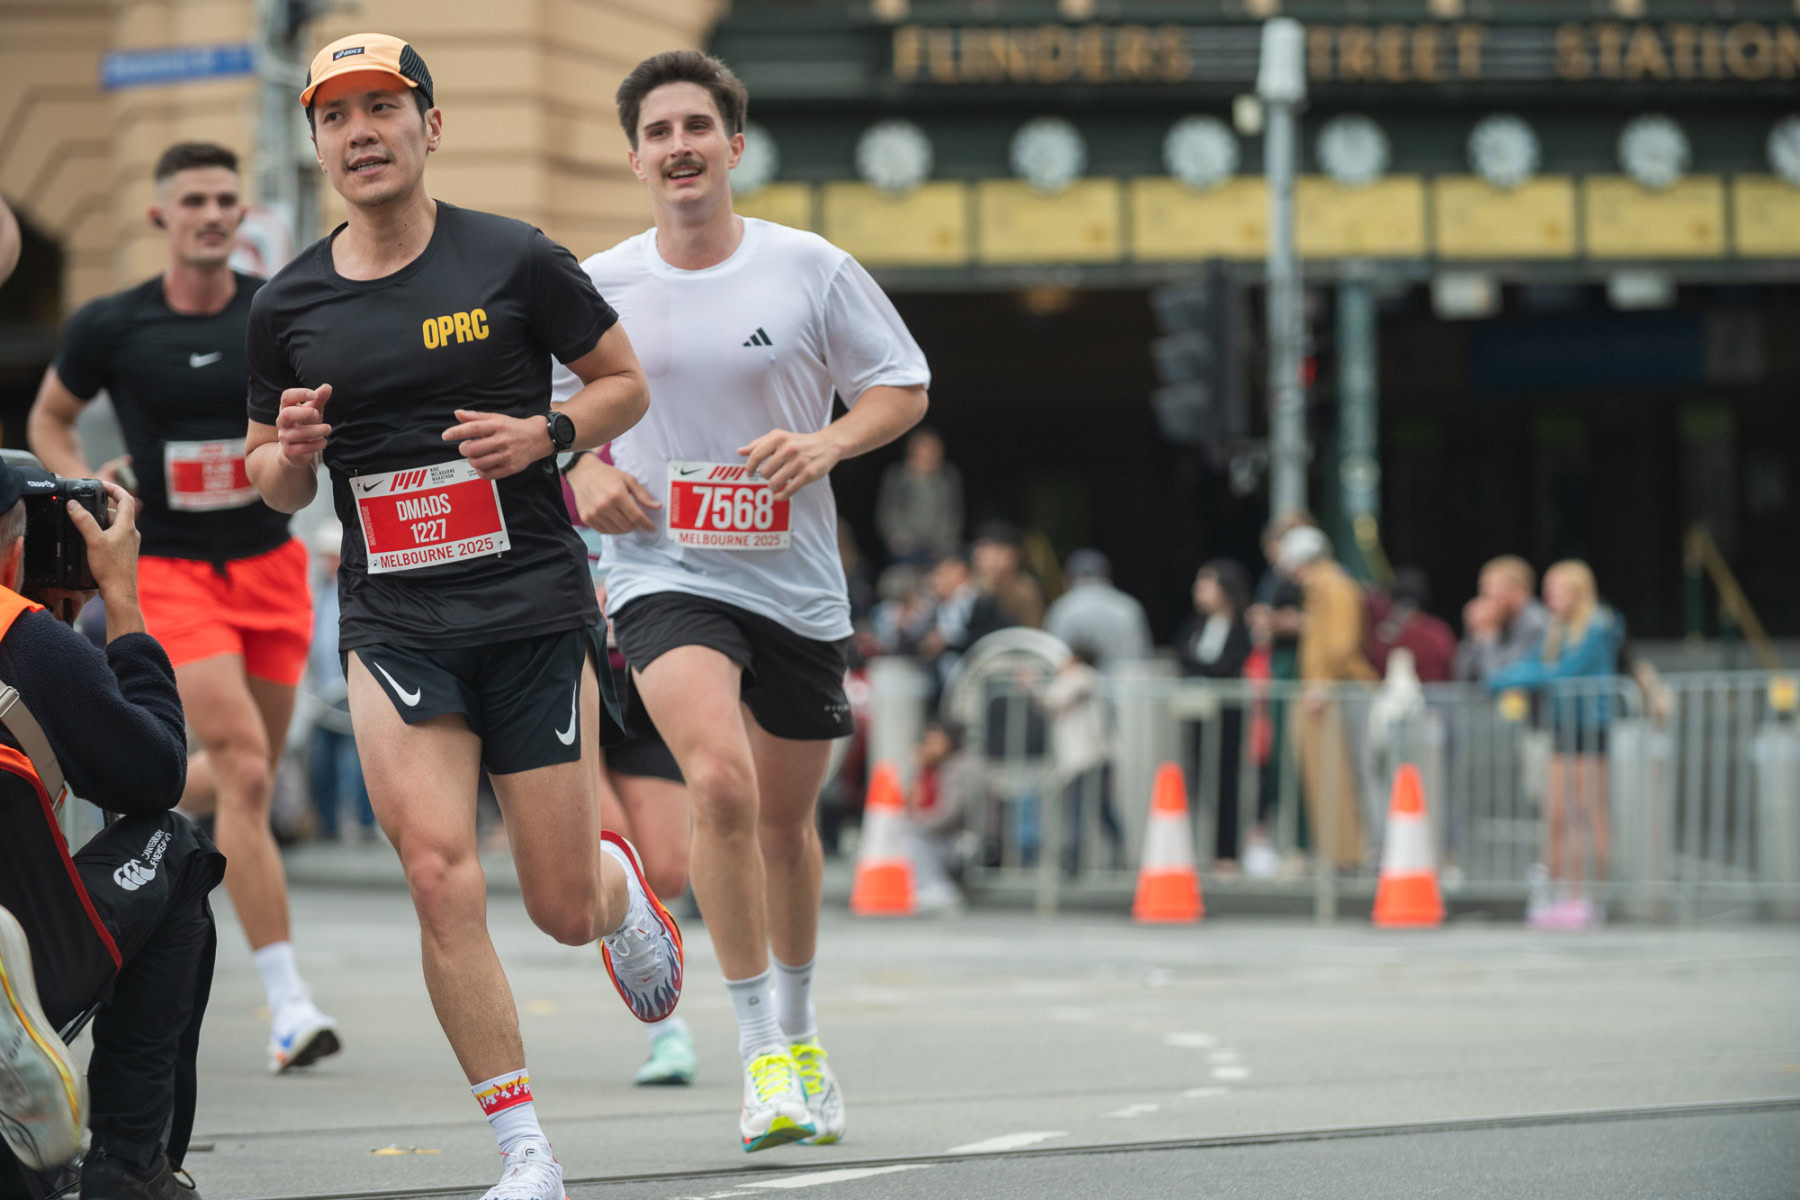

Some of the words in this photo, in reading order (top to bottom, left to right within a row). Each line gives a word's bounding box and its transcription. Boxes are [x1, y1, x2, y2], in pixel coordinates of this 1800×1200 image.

[893, 24, 1194, 84] FLINDERS
[422, 307, 490, 350] OPRC
[396, 493, 452, 522] DMADS
[692, 485, 774, 530] 7568
[410, 518, 447, 544] 1227
[679, 532, 749, 546] MELBOURNE
[753, 534, 781, 546] 2025
[380, 545, 455, 569] MELBOURNE
[458, 537, 494, 557] 2025
